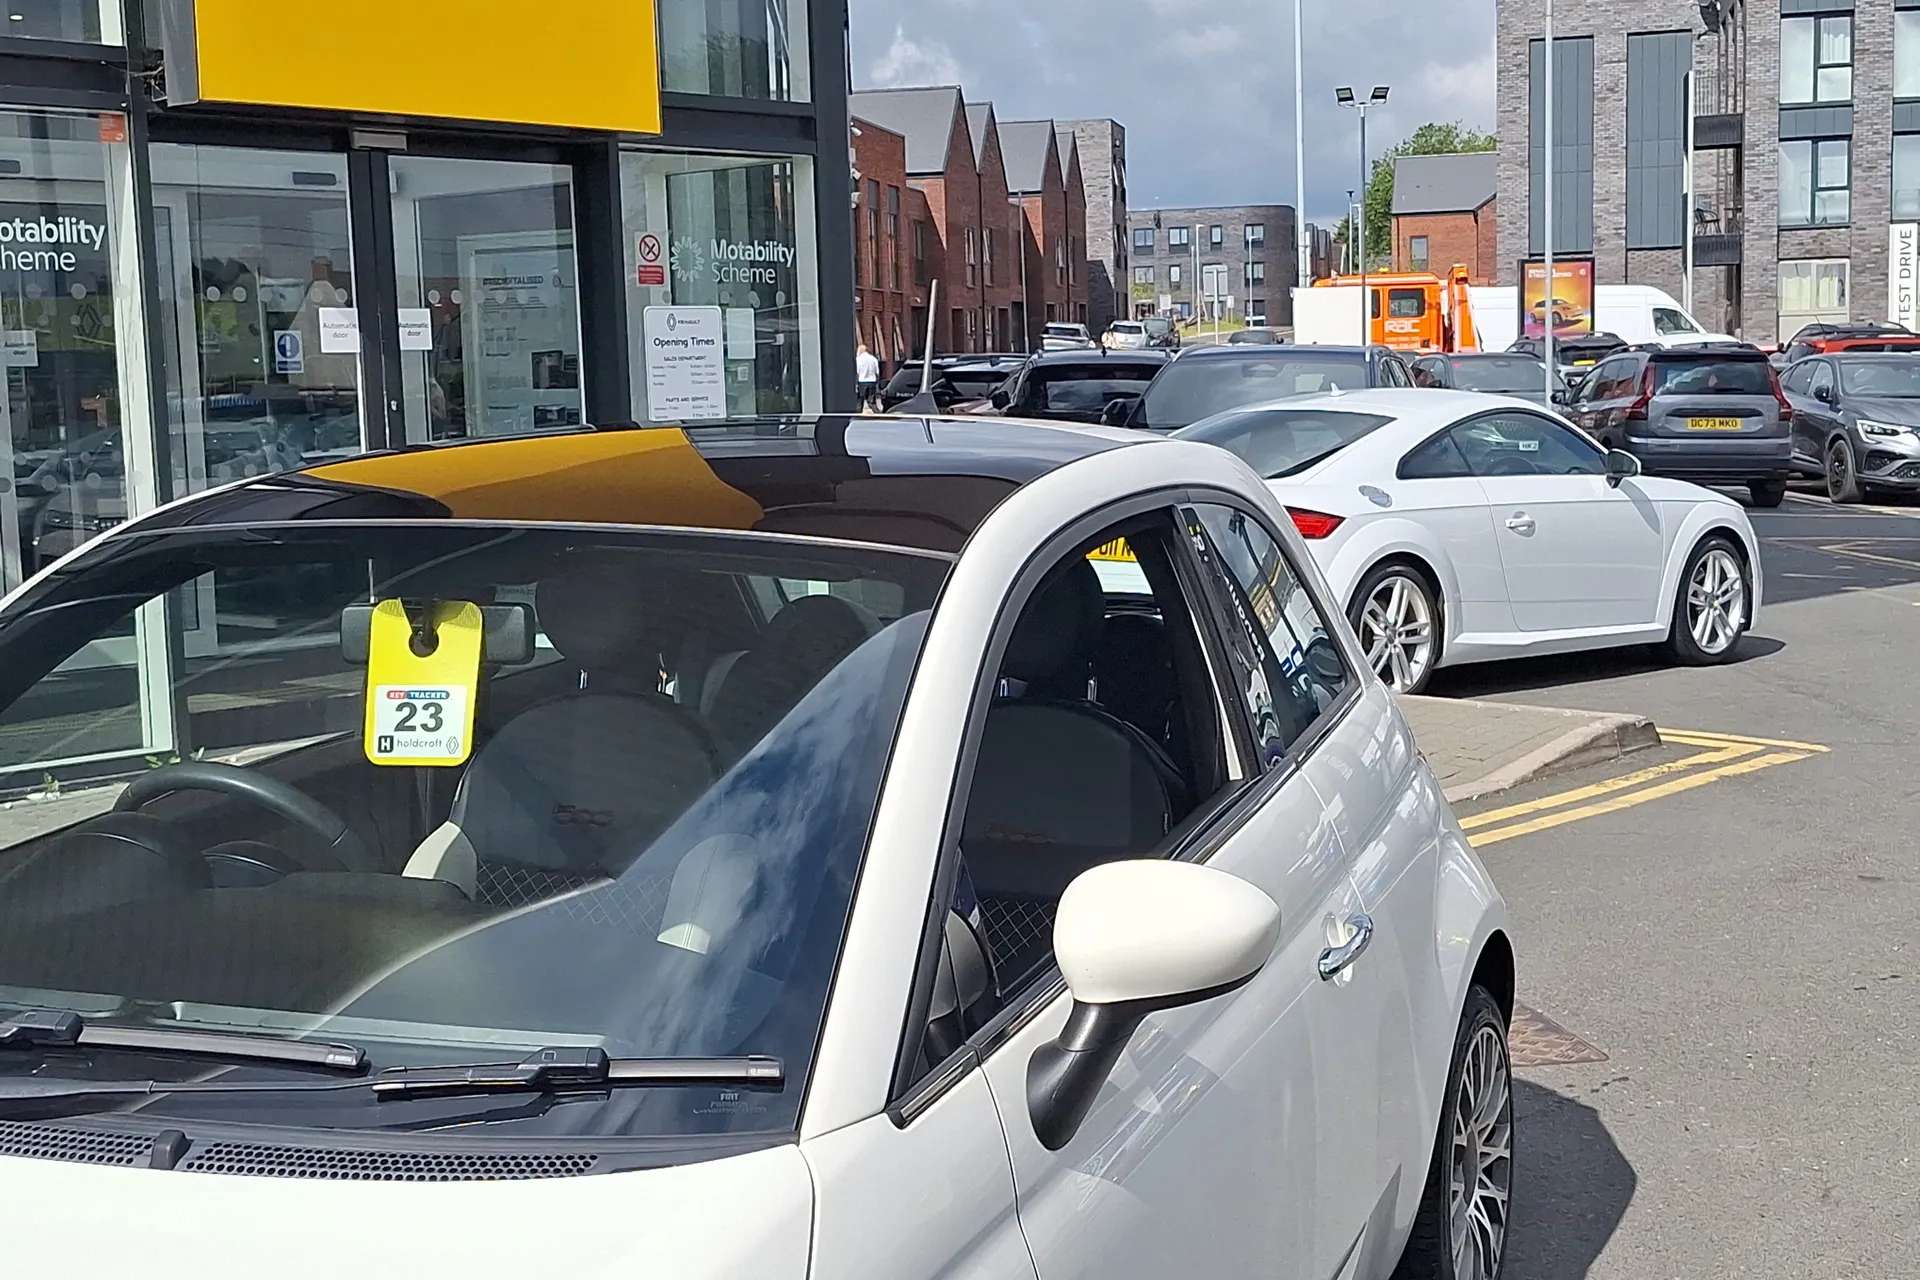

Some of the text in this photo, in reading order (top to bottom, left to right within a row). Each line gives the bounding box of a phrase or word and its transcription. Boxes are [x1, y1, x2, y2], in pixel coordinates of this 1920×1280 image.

[0, 244, 76, 271] heme
[711, 238, 794, 267] Motability
[712, 262, 776, 284] Scheme
[1898, 229, 1912, 324] TEST DRIVE
[1384, 320, 1420, 333] RAC
[653, 336, 715, 348] Opening Times
[1690, 418, 1716, 428] DC73
[389, 691, 447, 699] KEY TRACKER
[394, 702, 444, 732] 23
[397, 738, 442, 748] holdcroft
